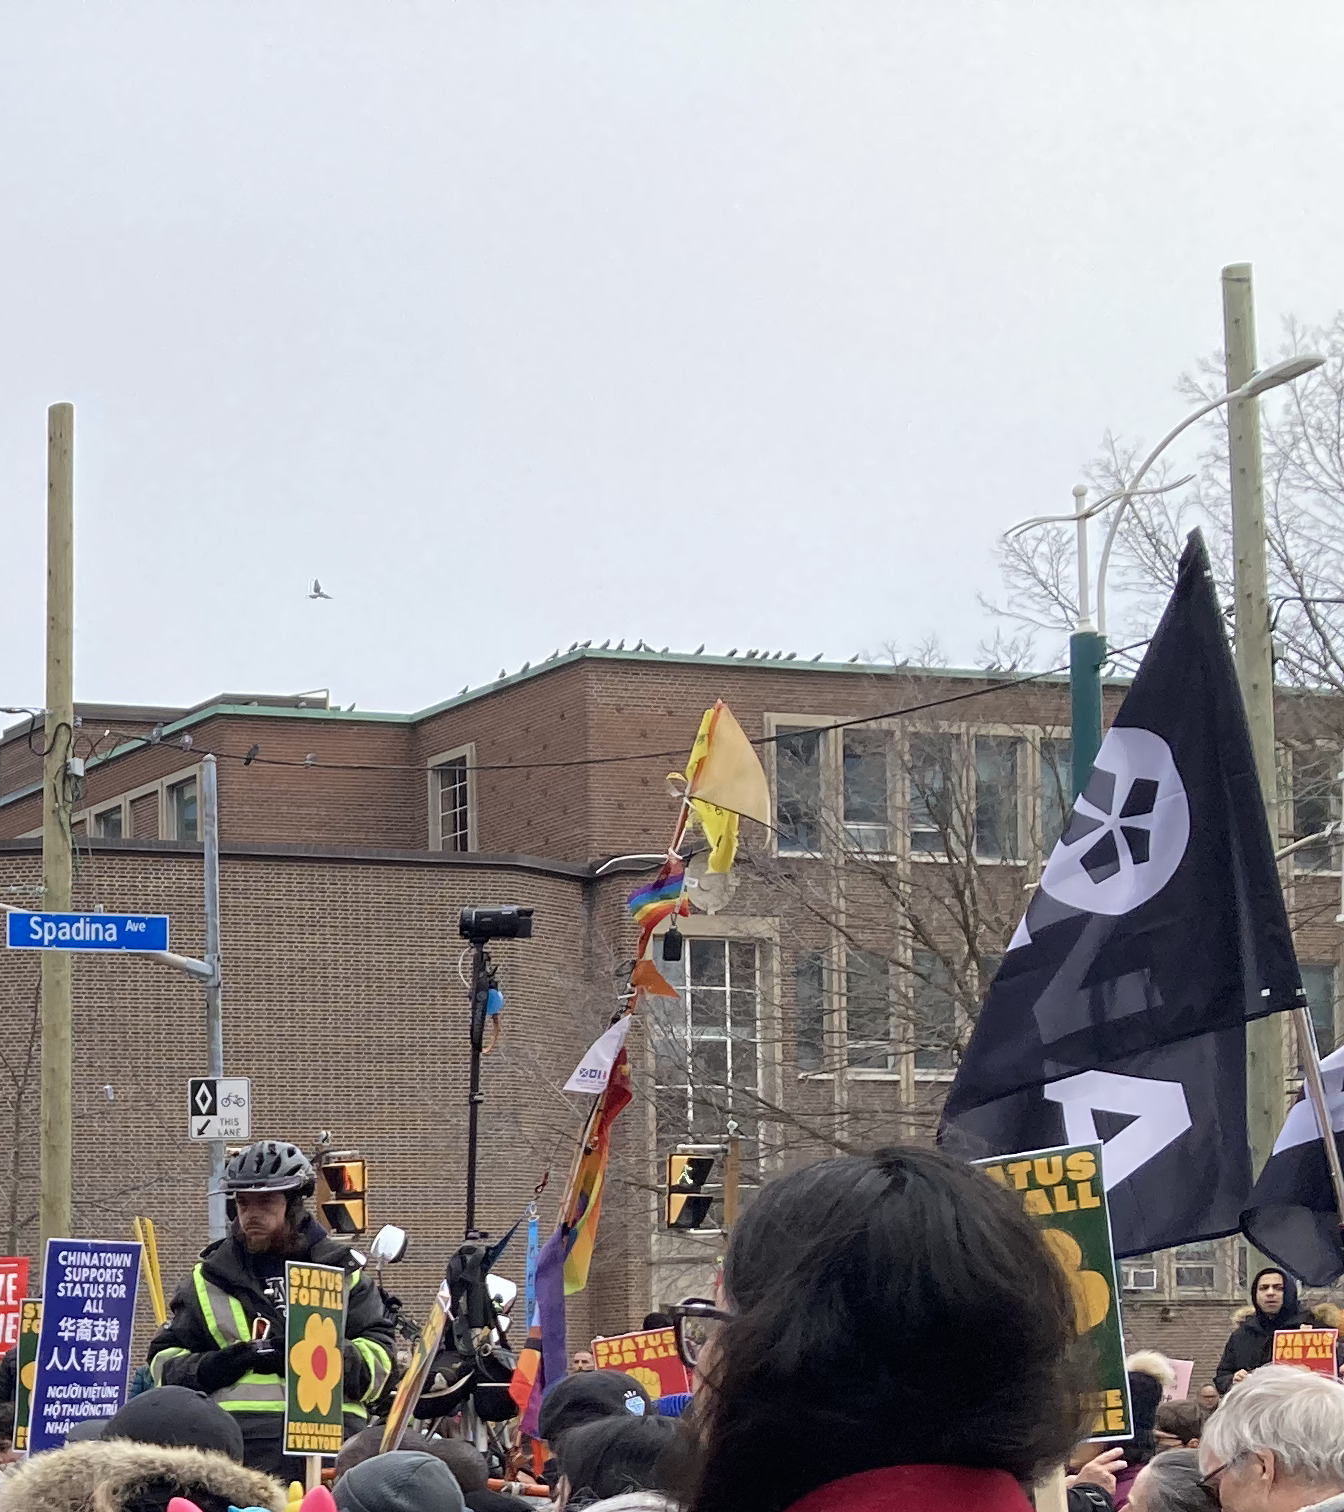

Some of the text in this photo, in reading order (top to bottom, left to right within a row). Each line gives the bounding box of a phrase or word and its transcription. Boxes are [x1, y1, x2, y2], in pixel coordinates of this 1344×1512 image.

[29, 915, 147, 947] Spadina Ave
[220, 1117, 240, 1127] THIS
[217, 1128, 242, 1138] LANE
[1022, 1181, 1101, 1215] ALL
[58, 1251, 132, 1268] CHINATOWN
[64, 1267, 124, 1283] SUPPORTS
[289, 1267, 343, 1292] STATUS
[56, 1282, 127, 1299] STATUS FOR
[289, 1286, 321, 1307] FOR
[322, 1290, 343, 1311] ALL
[82, 1299, 104, 1314] ALL
[57, 1316, 120, 1342] 华裔支持
[1276, 1332, 1334, 1347] STATUS
[595, 1331, 676, 1356] STATUS
[1275, 1345, 1333, 1360] FOR ALL
[45, 1346, 124, 1372] 人人有身份
[598, 1343, 678, 1369] FOR ALL
